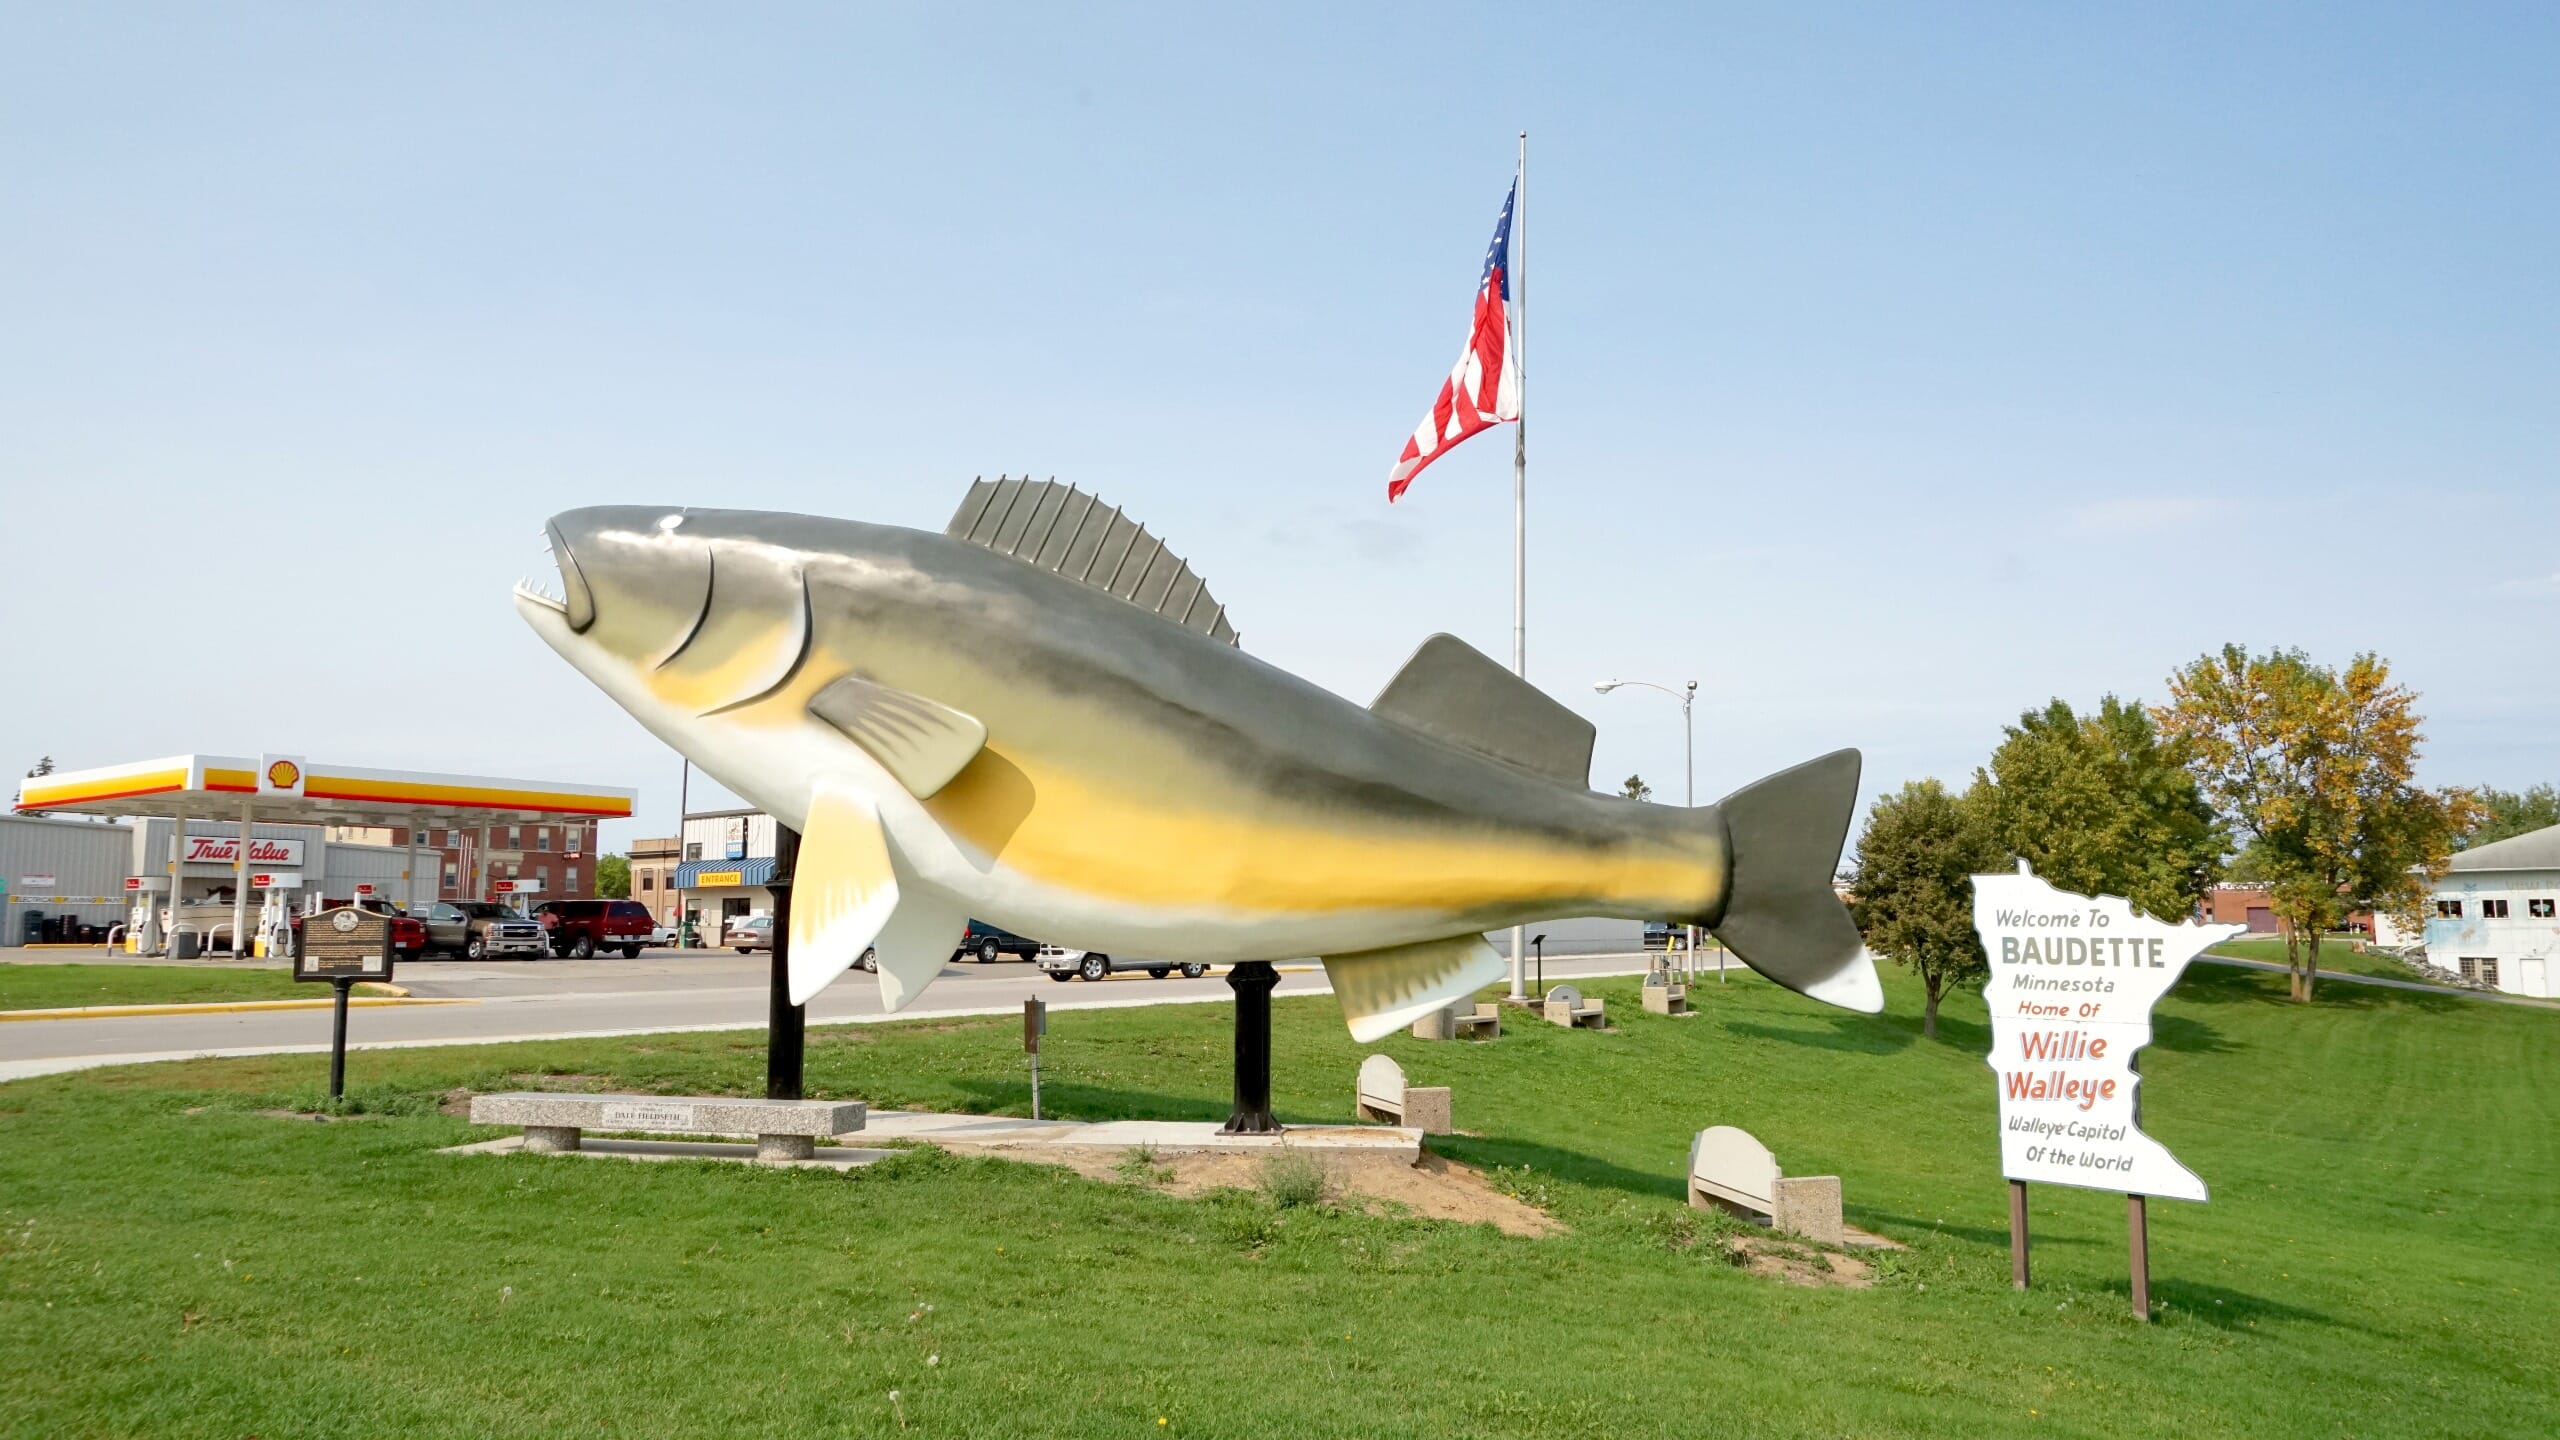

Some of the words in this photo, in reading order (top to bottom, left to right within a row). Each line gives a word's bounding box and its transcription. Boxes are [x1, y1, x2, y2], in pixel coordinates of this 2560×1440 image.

[187, 839, 233, 860] True
[224, 840, 290, 861] Value
[701, 874, 738, 884] ENTRANCE
[1996, 909, 2081, 928] Welcome
[2089, 908, 2110, 928] To
[2002, 936, 2165, 969] BAUDETTE
[2012, 974, 2115, 993] Minnesota
[2018, 1001, 2070, 1017] Home
[2079, 1003, 2102, 1018] Of
[2021, 1030, 2108, 1061] Willie
[2006, 1070, 2117, 1111] Walleye
[2008, 1116, 2065, 1140] Walleye
[2067, 1120, 2127, 1143] Capitol
[2026, 1145, 2047, 1163] Of
[2049, 1148, 2076, 1166] the
[2078, 1151, 2134, 1172] World
